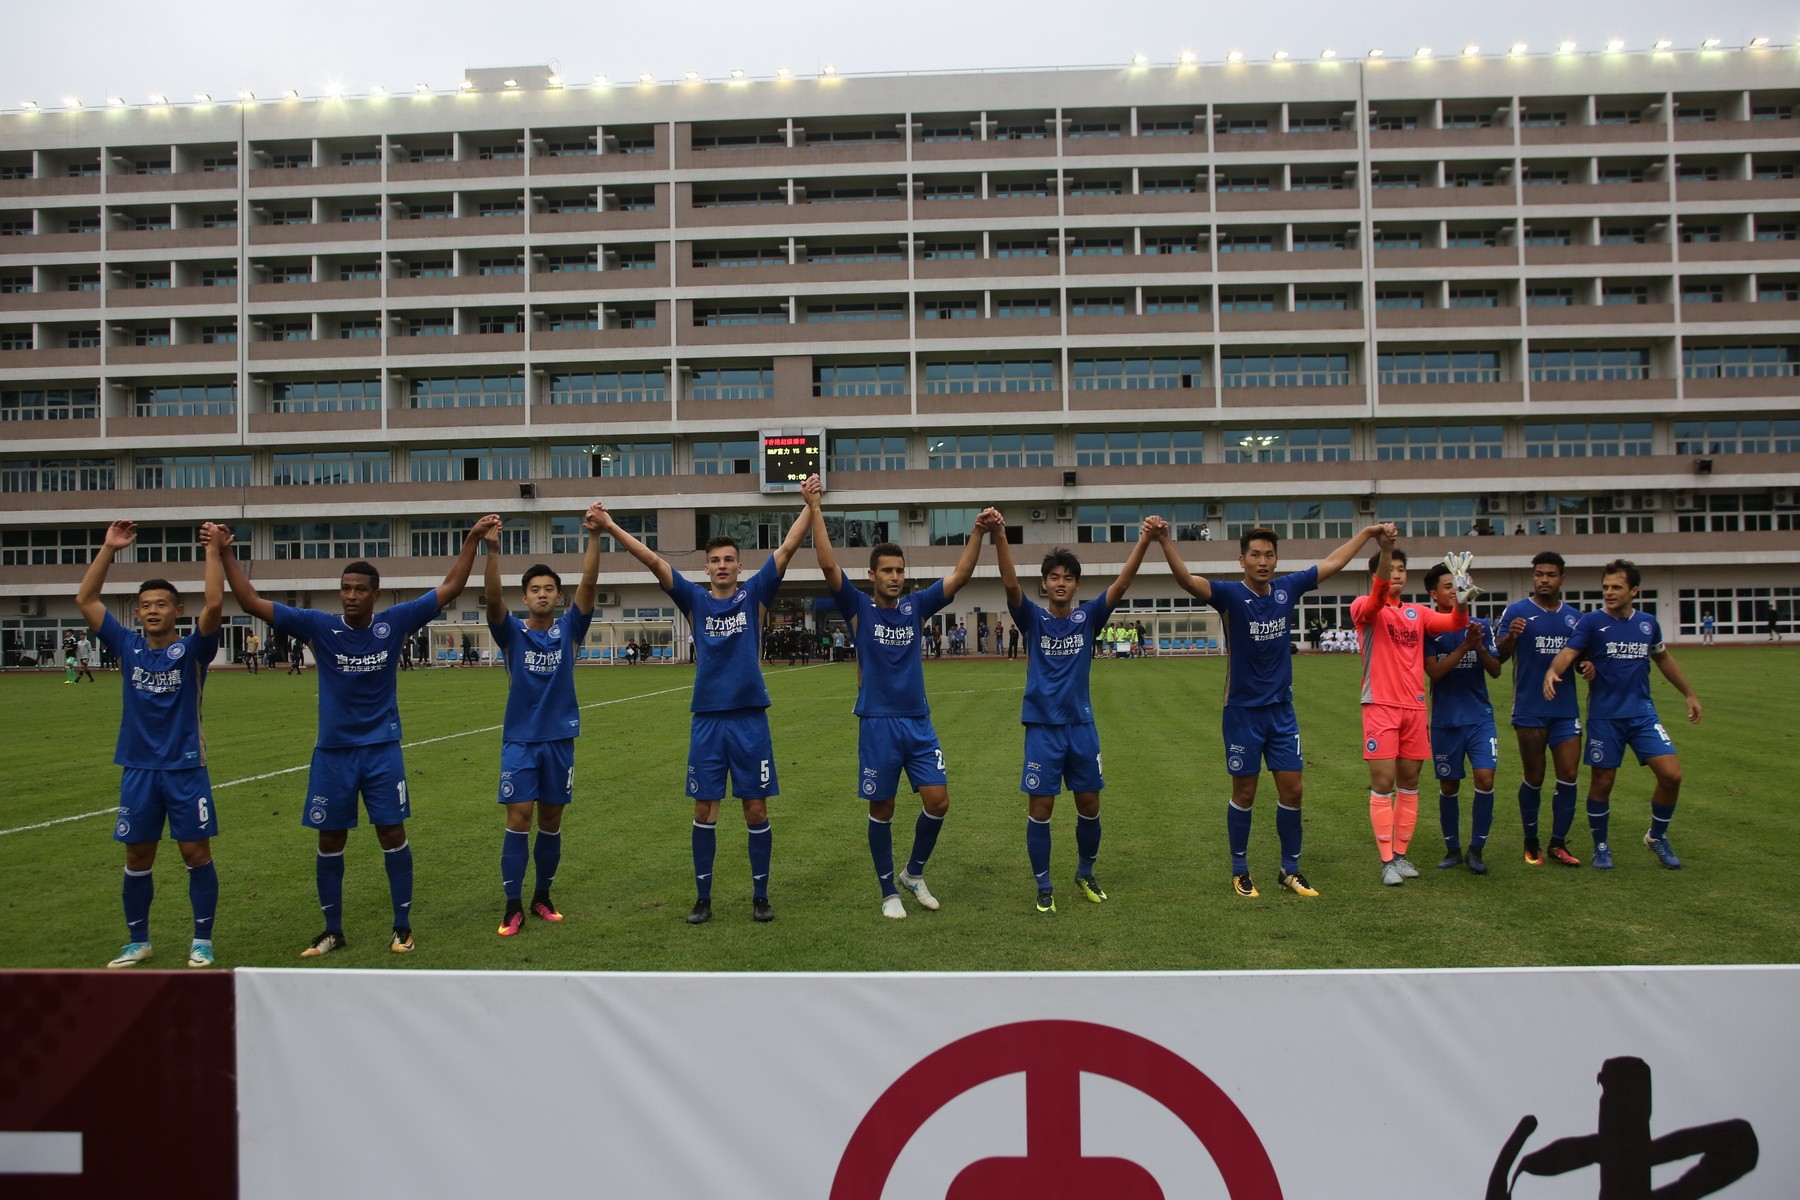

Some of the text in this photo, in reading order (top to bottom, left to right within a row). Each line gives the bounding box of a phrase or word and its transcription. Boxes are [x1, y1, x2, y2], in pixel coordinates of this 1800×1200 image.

[760, 759, 770, 782] 5
[396, 780, 406, 806] 11
[198, 797, 209, 822] 6
